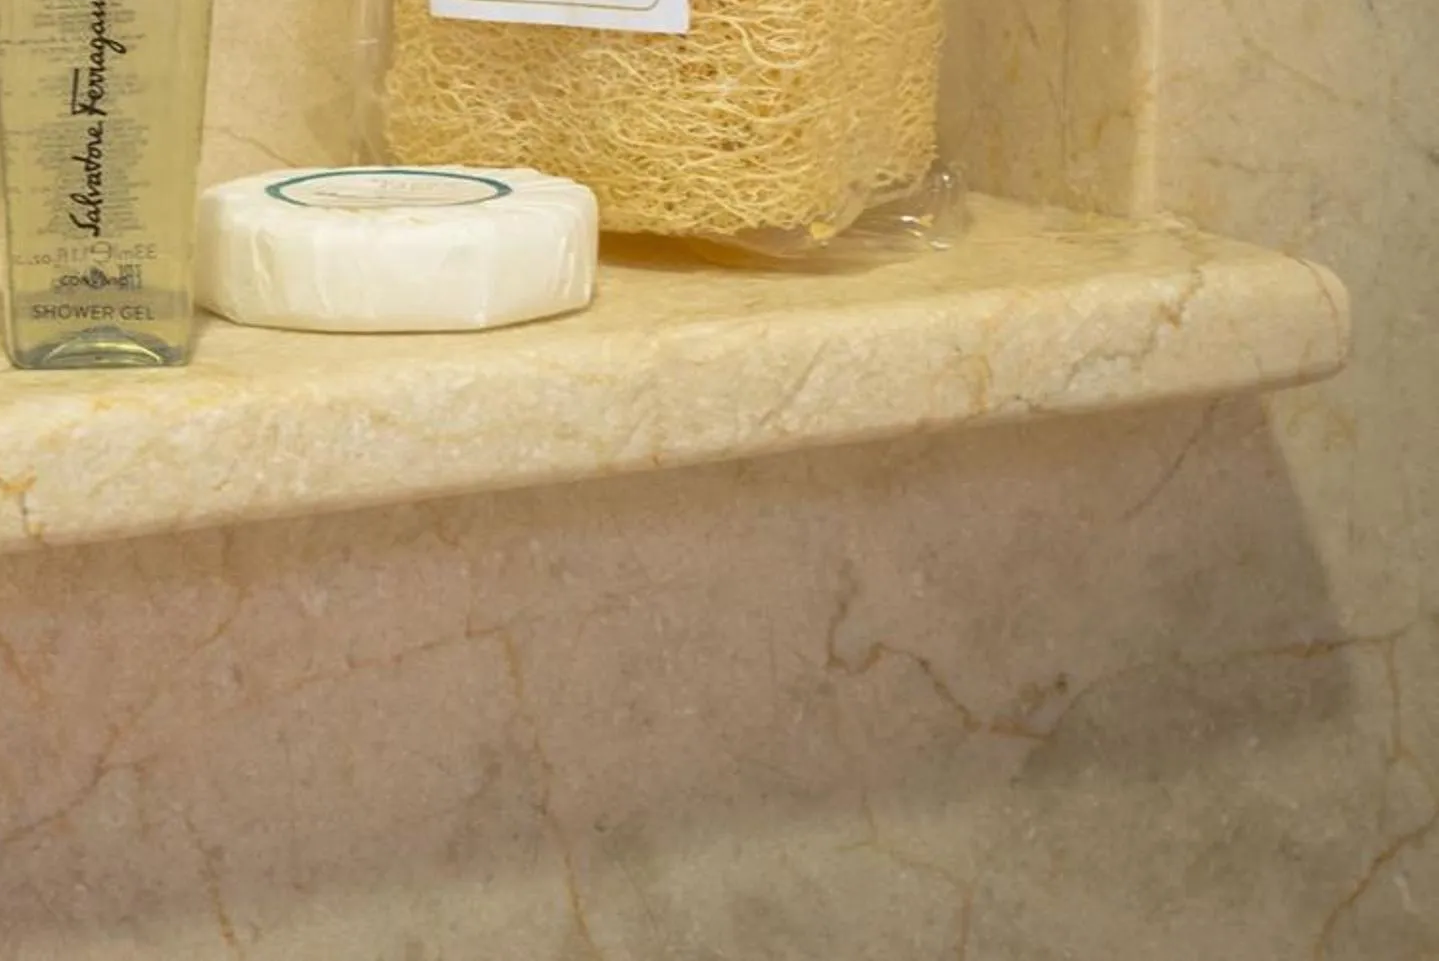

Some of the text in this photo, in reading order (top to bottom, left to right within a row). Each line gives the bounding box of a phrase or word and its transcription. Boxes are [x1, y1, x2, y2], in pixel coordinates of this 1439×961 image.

[68, 121, 104, 238] Salvatore
[32, 303, 156, 321] SHOWER GEL
